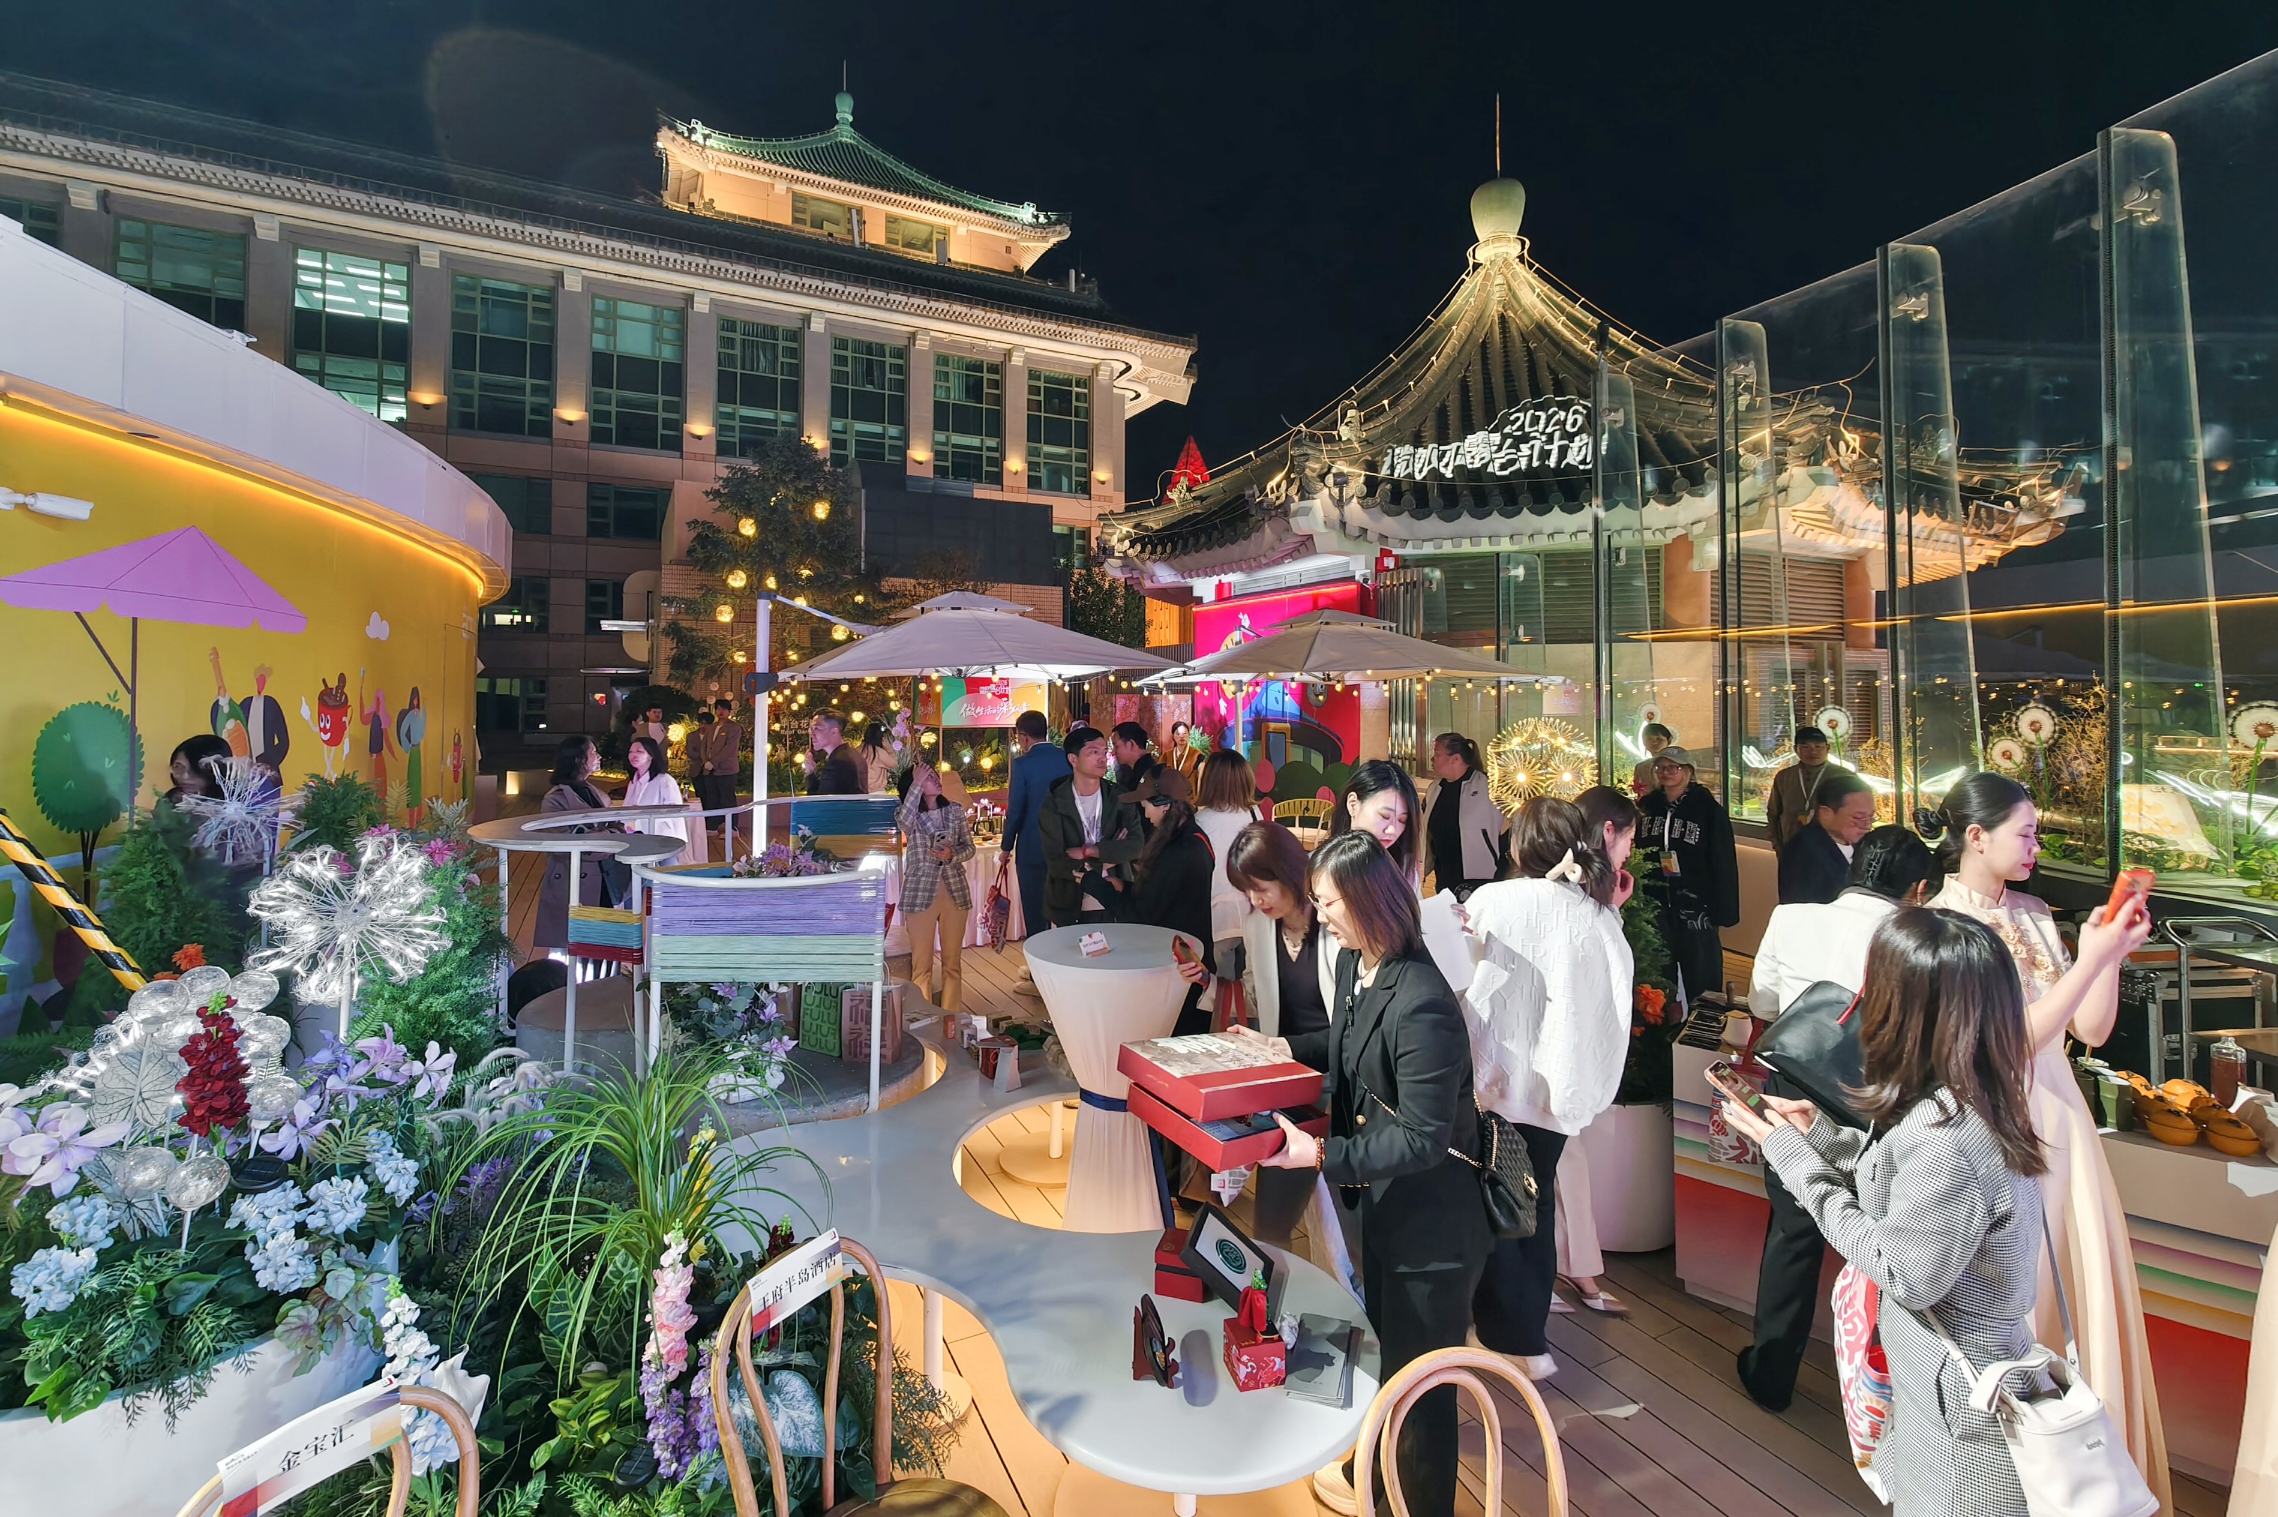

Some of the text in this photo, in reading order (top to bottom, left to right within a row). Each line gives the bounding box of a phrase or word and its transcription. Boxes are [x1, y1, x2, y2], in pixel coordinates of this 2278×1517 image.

[1503, 404, 1588, 435] 2026
[781, 718, 811, 729] 平台花
[758, 1251, 837, 1310] 王府半岛酒店
[277, 1419, 355, 1477] 金宝汇
